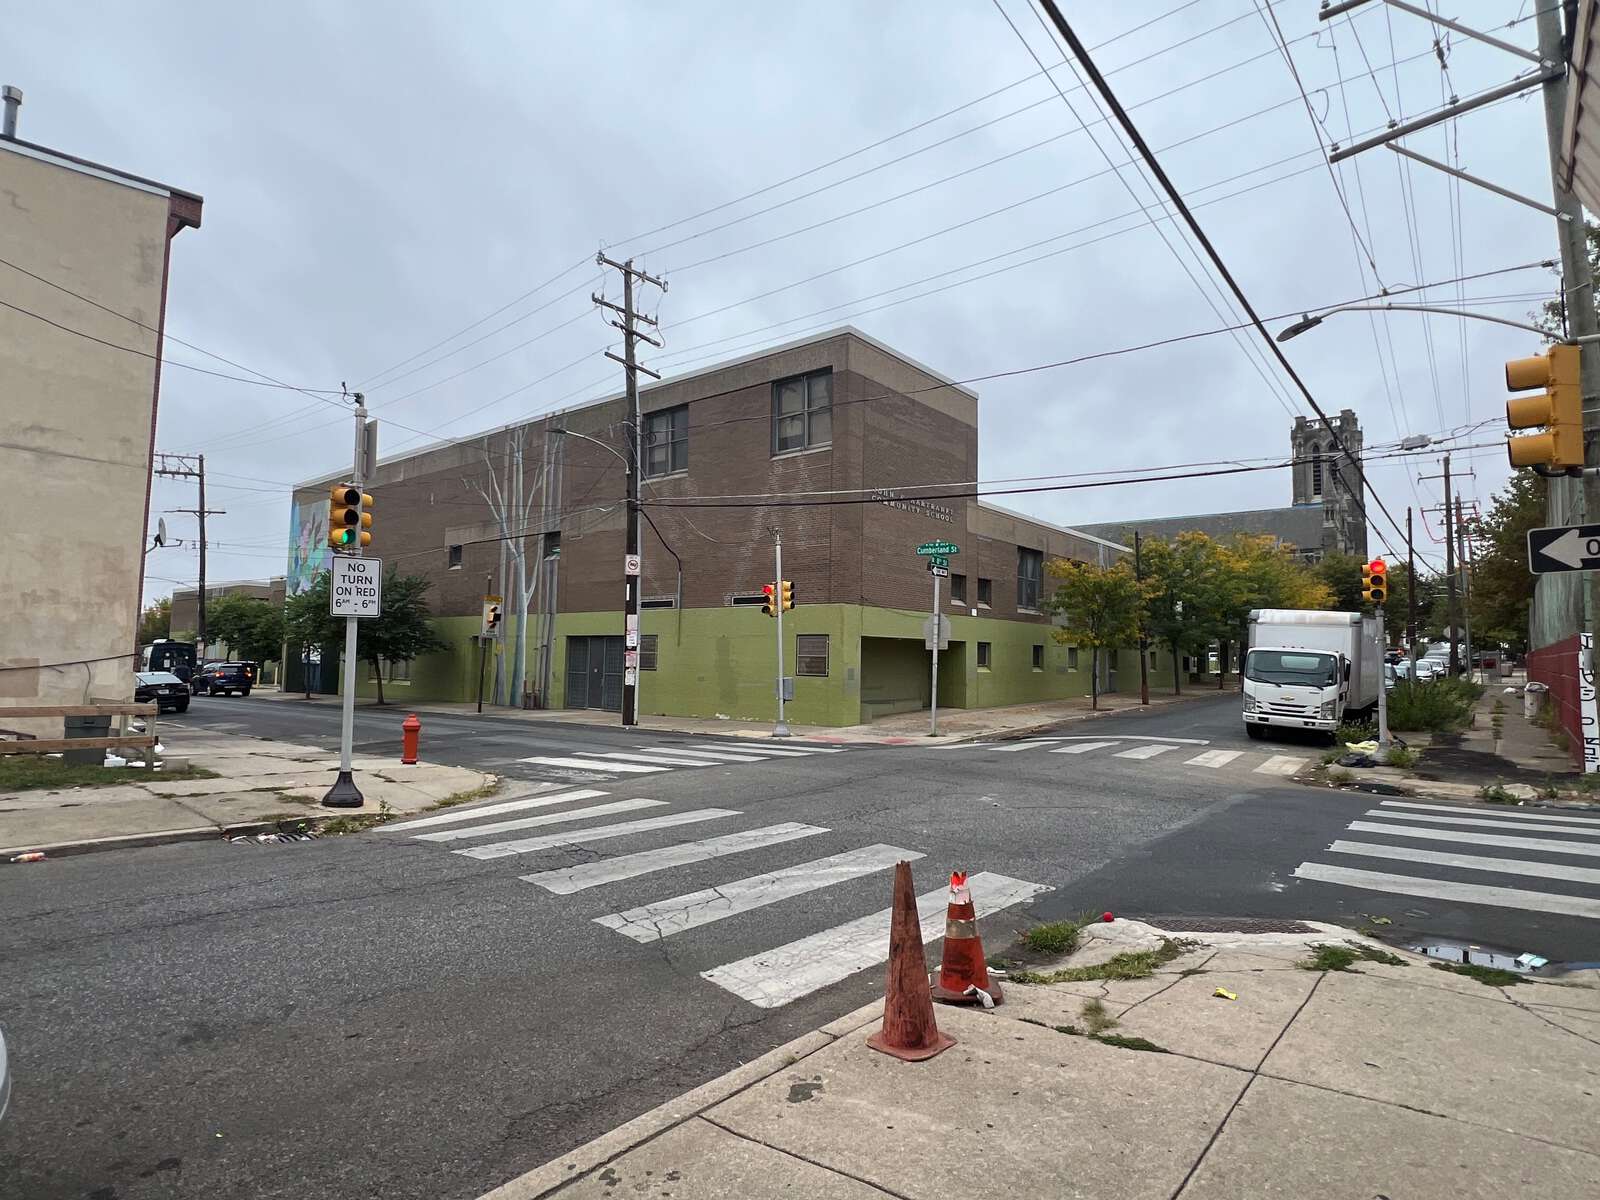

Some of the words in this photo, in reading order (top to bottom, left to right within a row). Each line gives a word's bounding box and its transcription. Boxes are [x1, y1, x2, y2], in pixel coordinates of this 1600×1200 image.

[917, 546, 949, 554] Cumberland
[348, 563, 366, 572] NO
[341, 574, 372, 584] TURN
[336, 586, 352, 596] ON
[356, 588, 376, 596] RED
